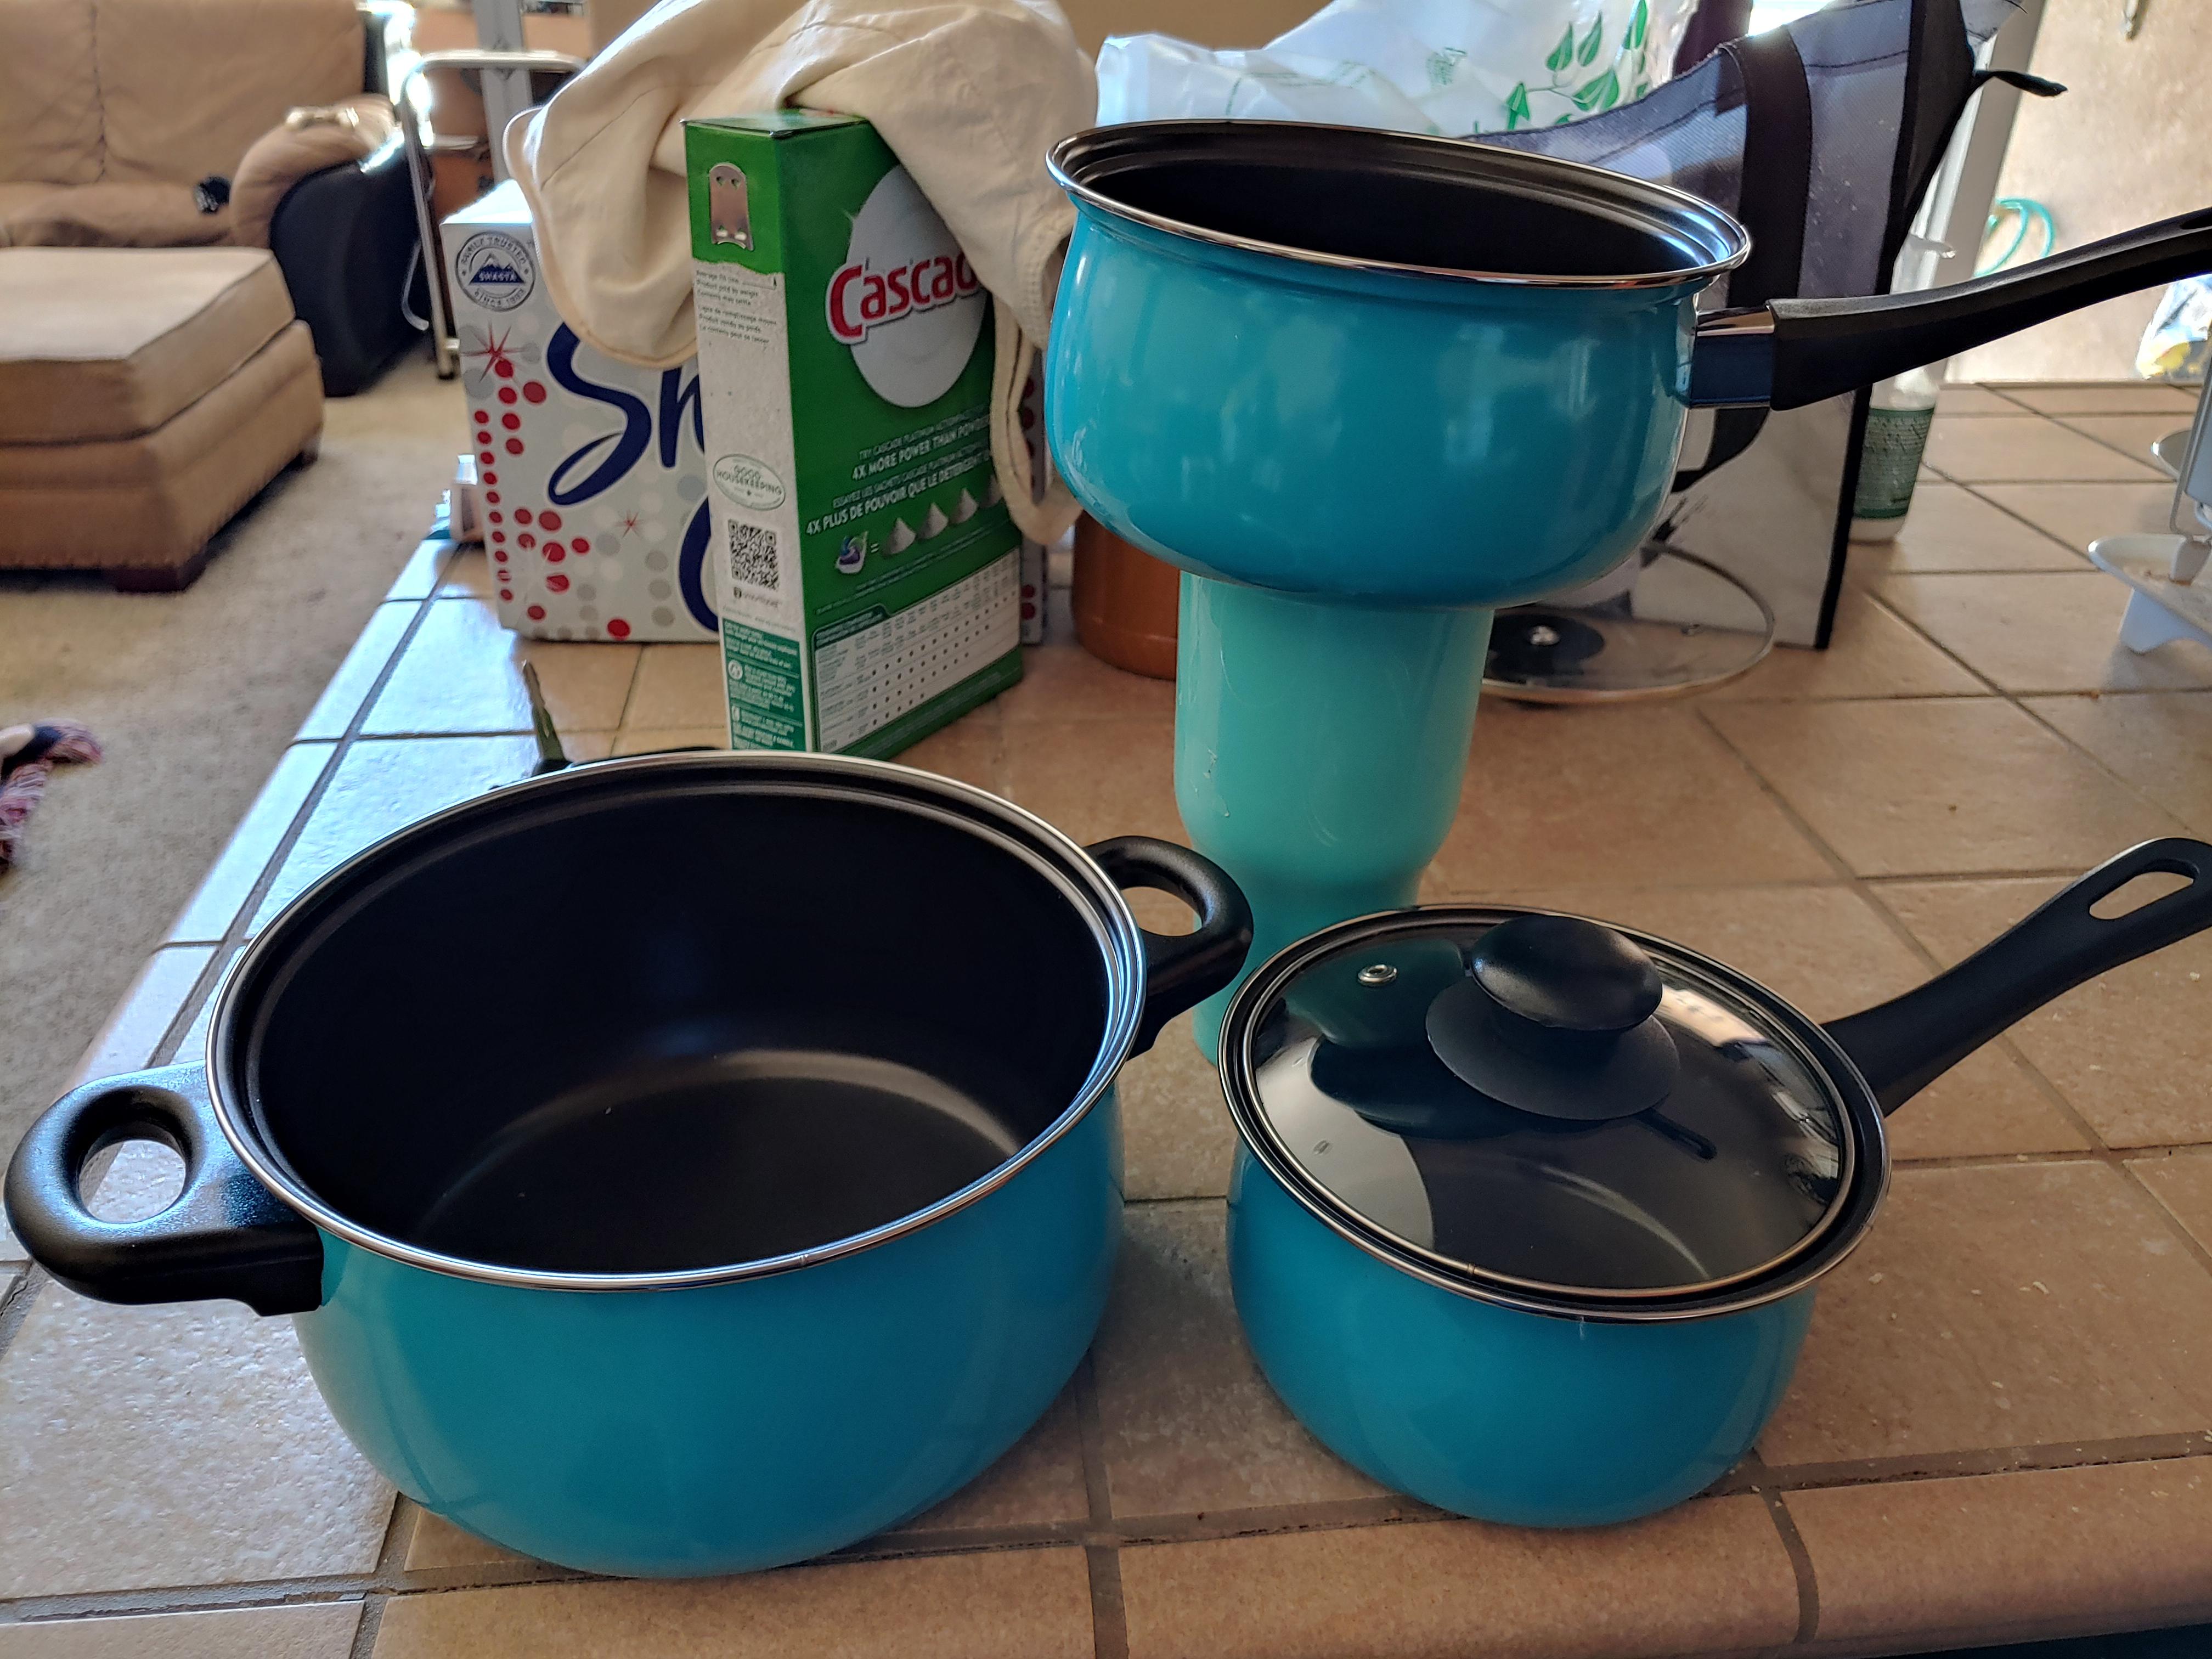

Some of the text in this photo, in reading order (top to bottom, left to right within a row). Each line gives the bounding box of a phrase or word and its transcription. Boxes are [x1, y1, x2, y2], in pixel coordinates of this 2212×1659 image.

[478, 271, 517, 281] SHASTA
[853, 464, 867, 480] 4X
[868, 453, 898, 476] MORE
[899, 439, 930, 463] POWER
[716, 471, 782, 495] HOUSEKEEPING
[734, 465, 761, 481] GOOD
[806, 519, 822, 535] 4X
[823, 508, 849, 531] PLUS
[850, 502, 864, 521] DE
[865, 486, 907, 514] POUVOIR
[907, 476, 927, 498] QUE
[928, 472, 938, 488] LE
